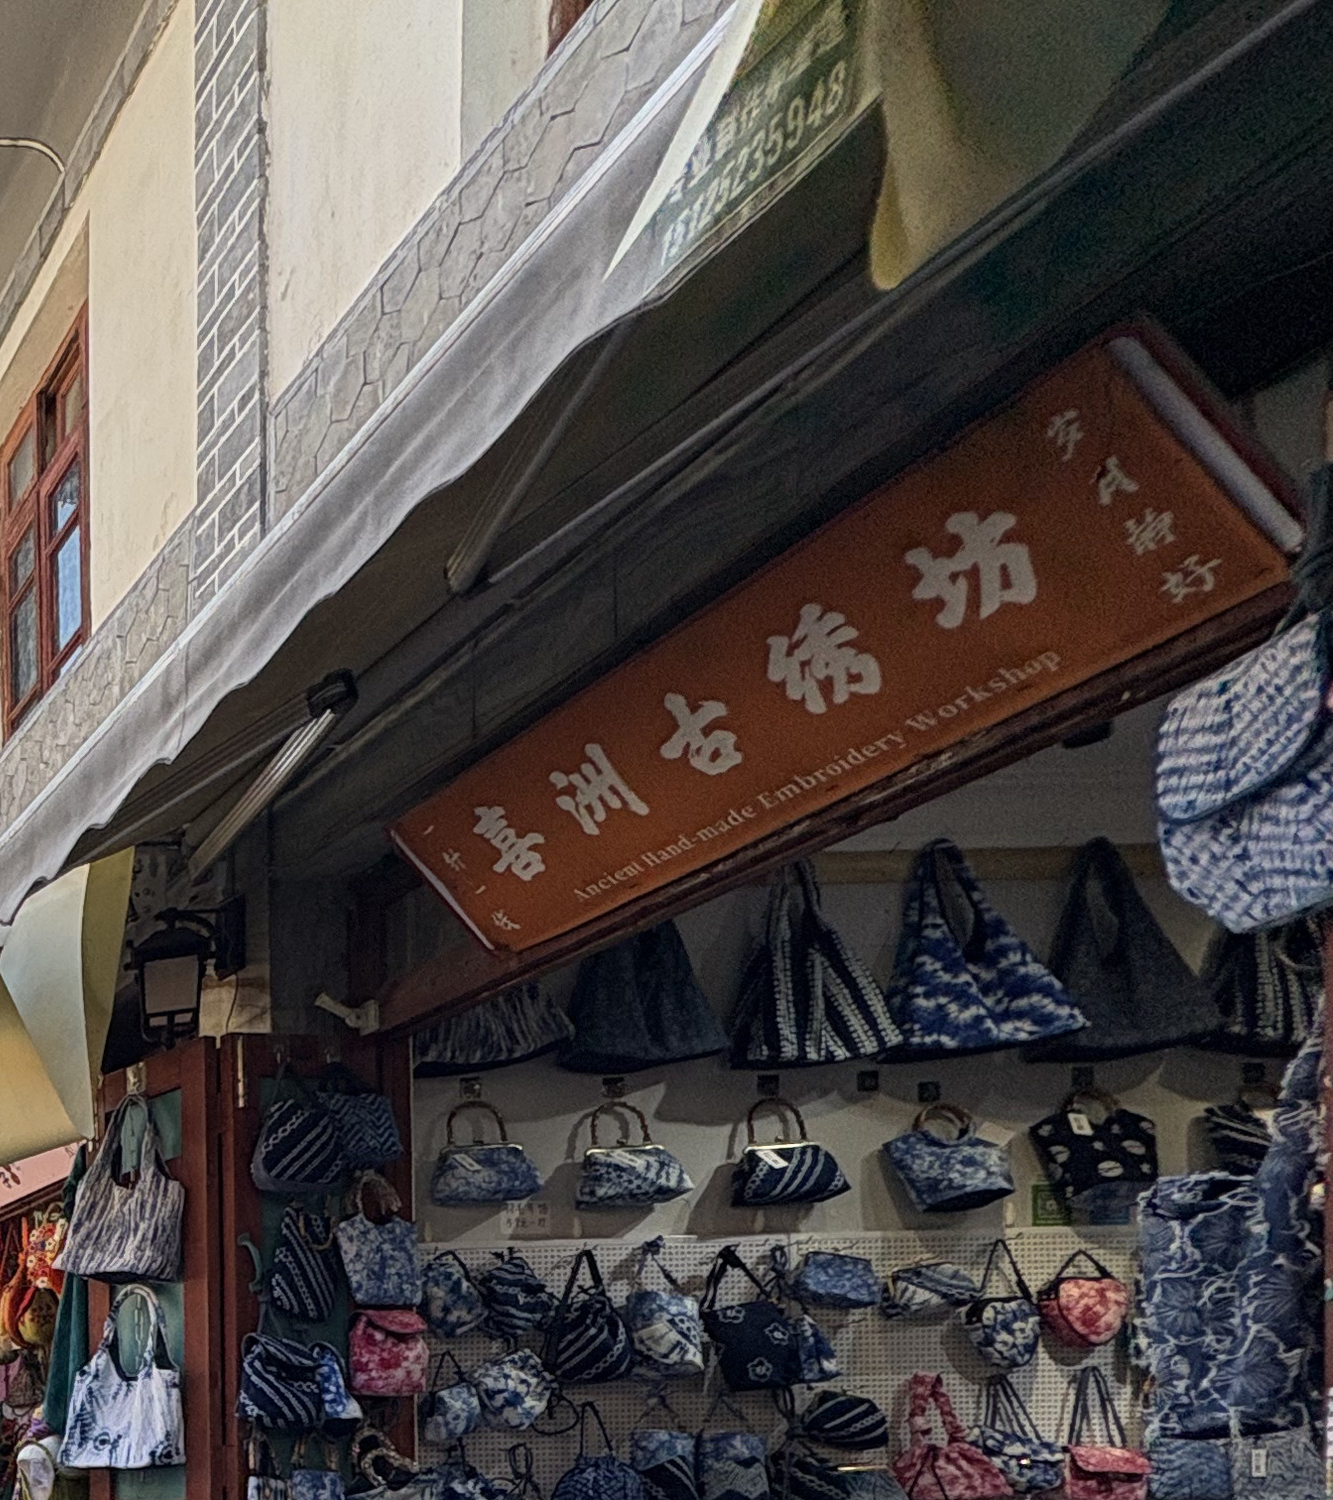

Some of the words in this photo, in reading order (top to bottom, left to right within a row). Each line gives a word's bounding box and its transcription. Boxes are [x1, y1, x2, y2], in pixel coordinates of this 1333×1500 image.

[471, 508, 1042, 883] 喜洲古绣坊
[573, 862, 644, 901] Ancient
[641, 805, 757, 867] Hand-made
[757, 730, 907, 810] Embroidery
[905, 650, 1061, 732] Workshop
